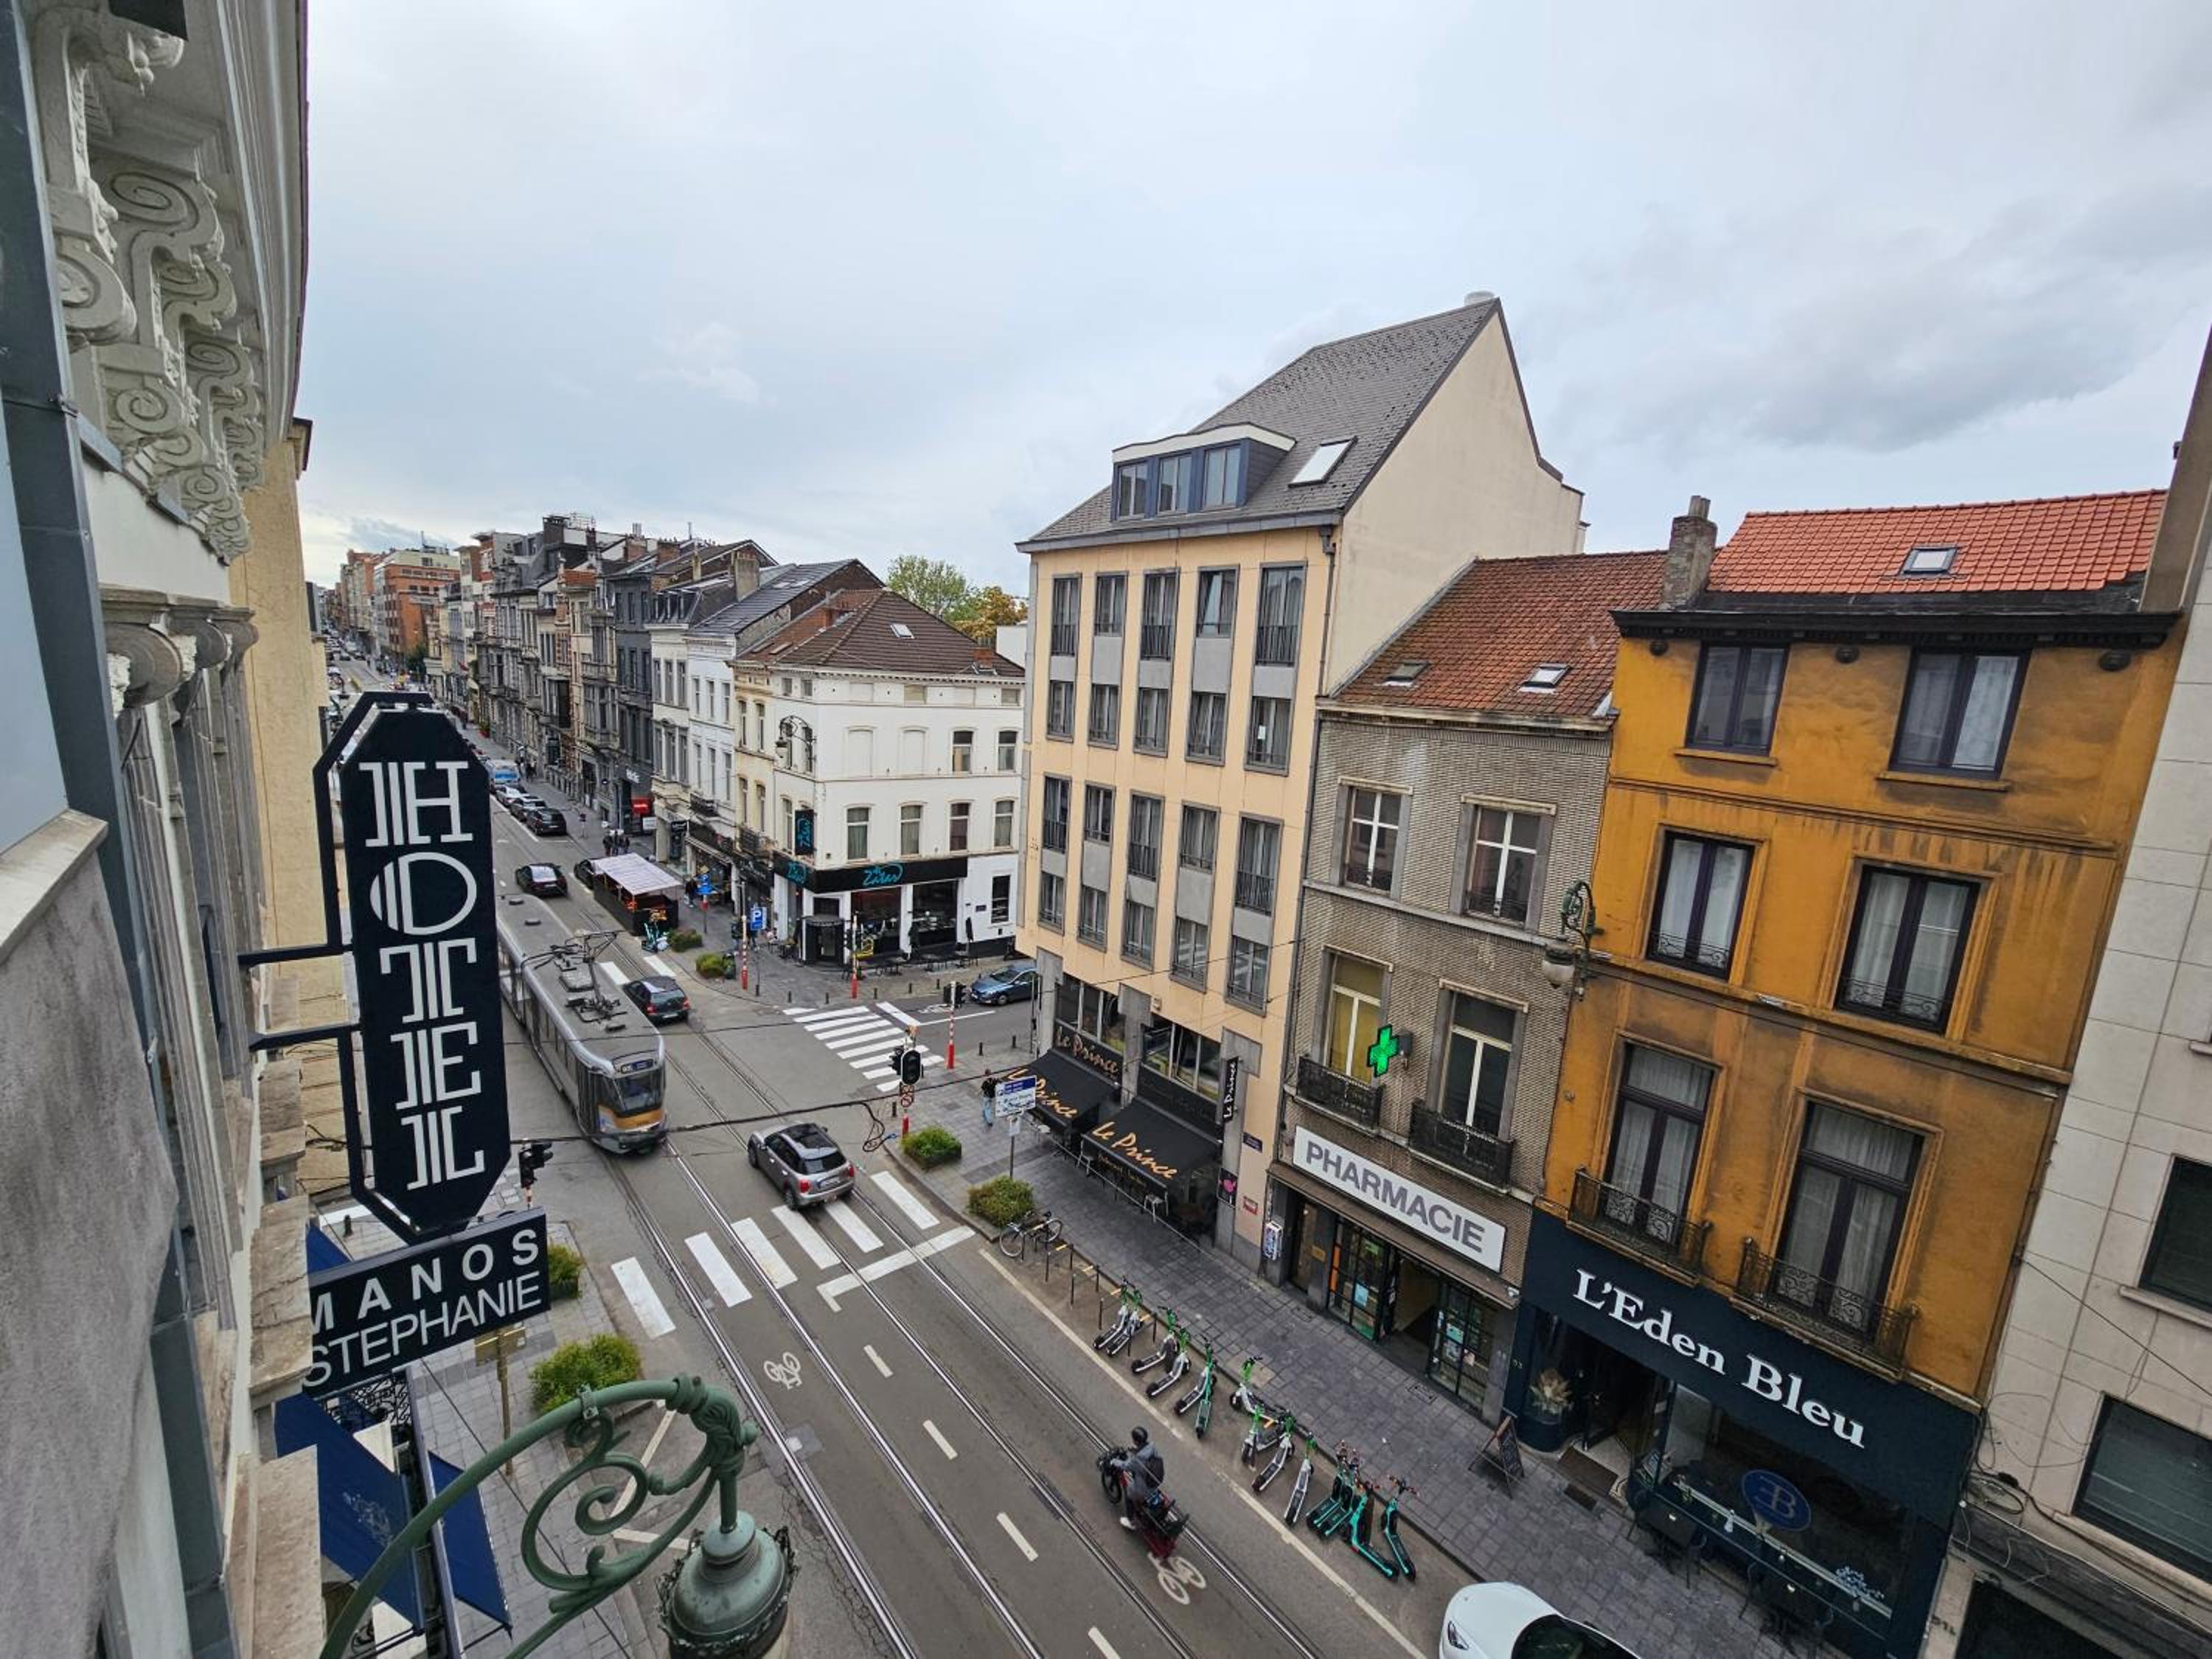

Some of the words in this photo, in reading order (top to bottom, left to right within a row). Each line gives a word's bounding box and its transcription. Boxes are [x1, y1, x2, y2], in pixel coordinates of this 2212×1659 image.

[752, 911, 762, 922] P
[358, 761, 485, 1190] HOTEL
[1073, 1033, 1119, 1074] Prince
[1223, 1062, 1237, 1104] Prince
[1223, 1105, 1232, 1119] Le
[1091, 1121, 1115, 1141] Le
[1110, 1132, 1178, 1180] Prince
[1306, 1140, 1486, 1253] PHARMACIE
[303, 1270, 543, 1387] STEPHANIE
[1572, 1268, 1726, 1376] L'Eden
[1741, 1354, 1865, 1450] Bleu
